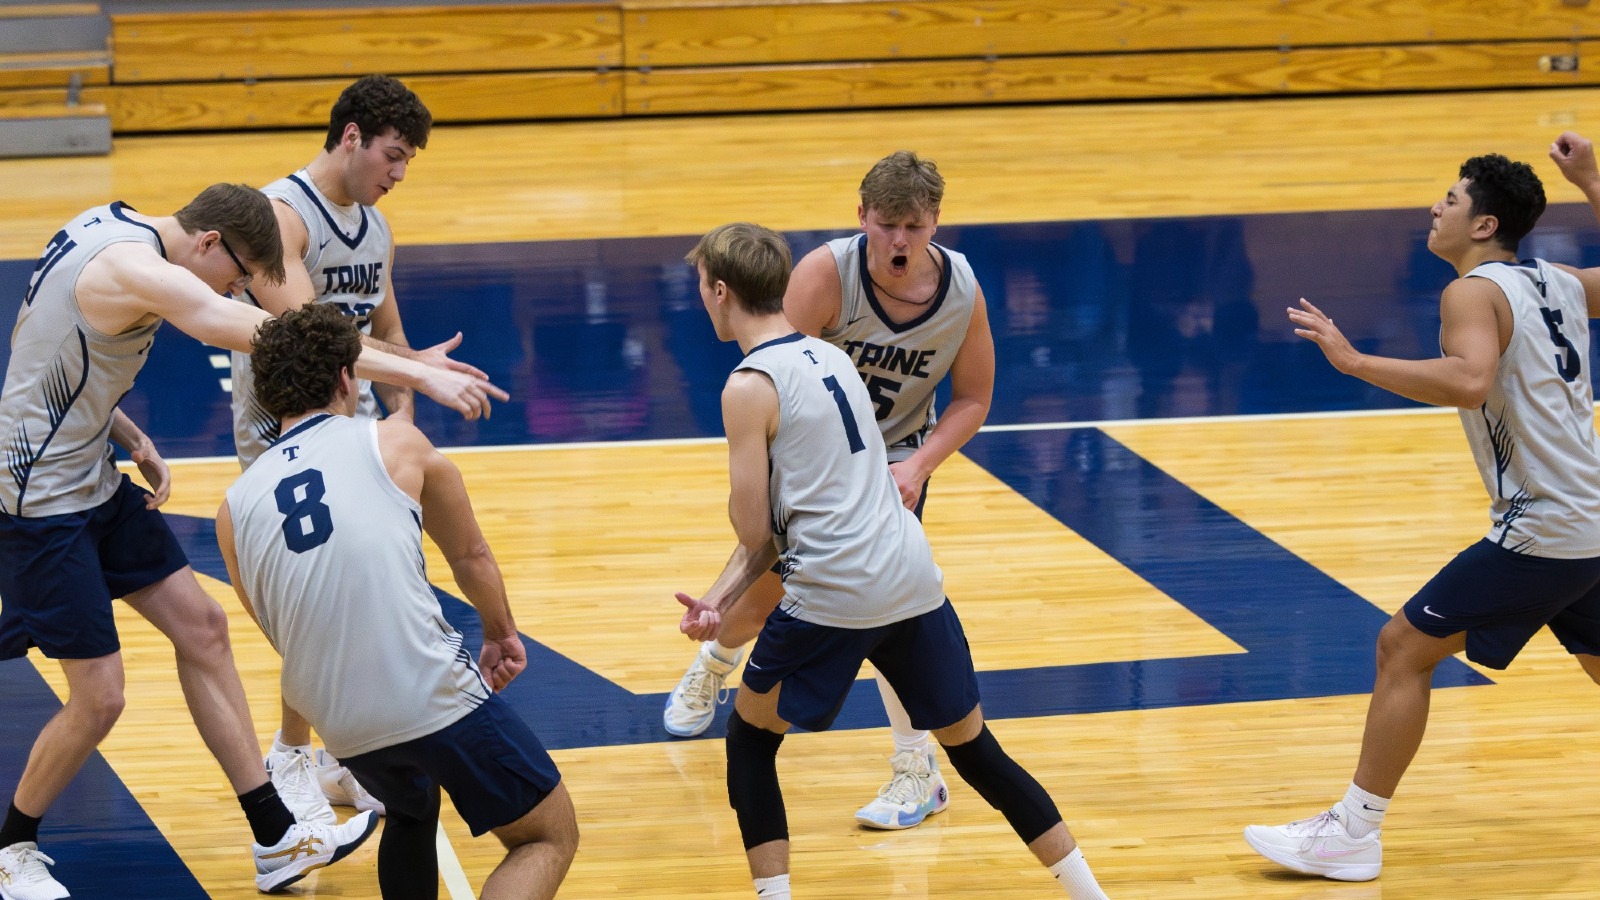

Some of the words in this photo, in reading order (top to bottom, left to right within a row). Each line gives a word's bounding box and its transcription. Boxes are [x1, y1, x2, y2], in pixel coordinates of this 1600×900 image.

[84, 217, 102, 228] T
[321, 262, 382, 295] TRINE
[803, 350, 818, 364] T
[843, 340, 936, 378] TRINE
[1539, 307, 1580, 382] 5
[822, 374, 866, 454] 1
[858, 371, 902, 421] 5
[282, 445, 300, 462] T
[273, 467, 334, 554] 8
